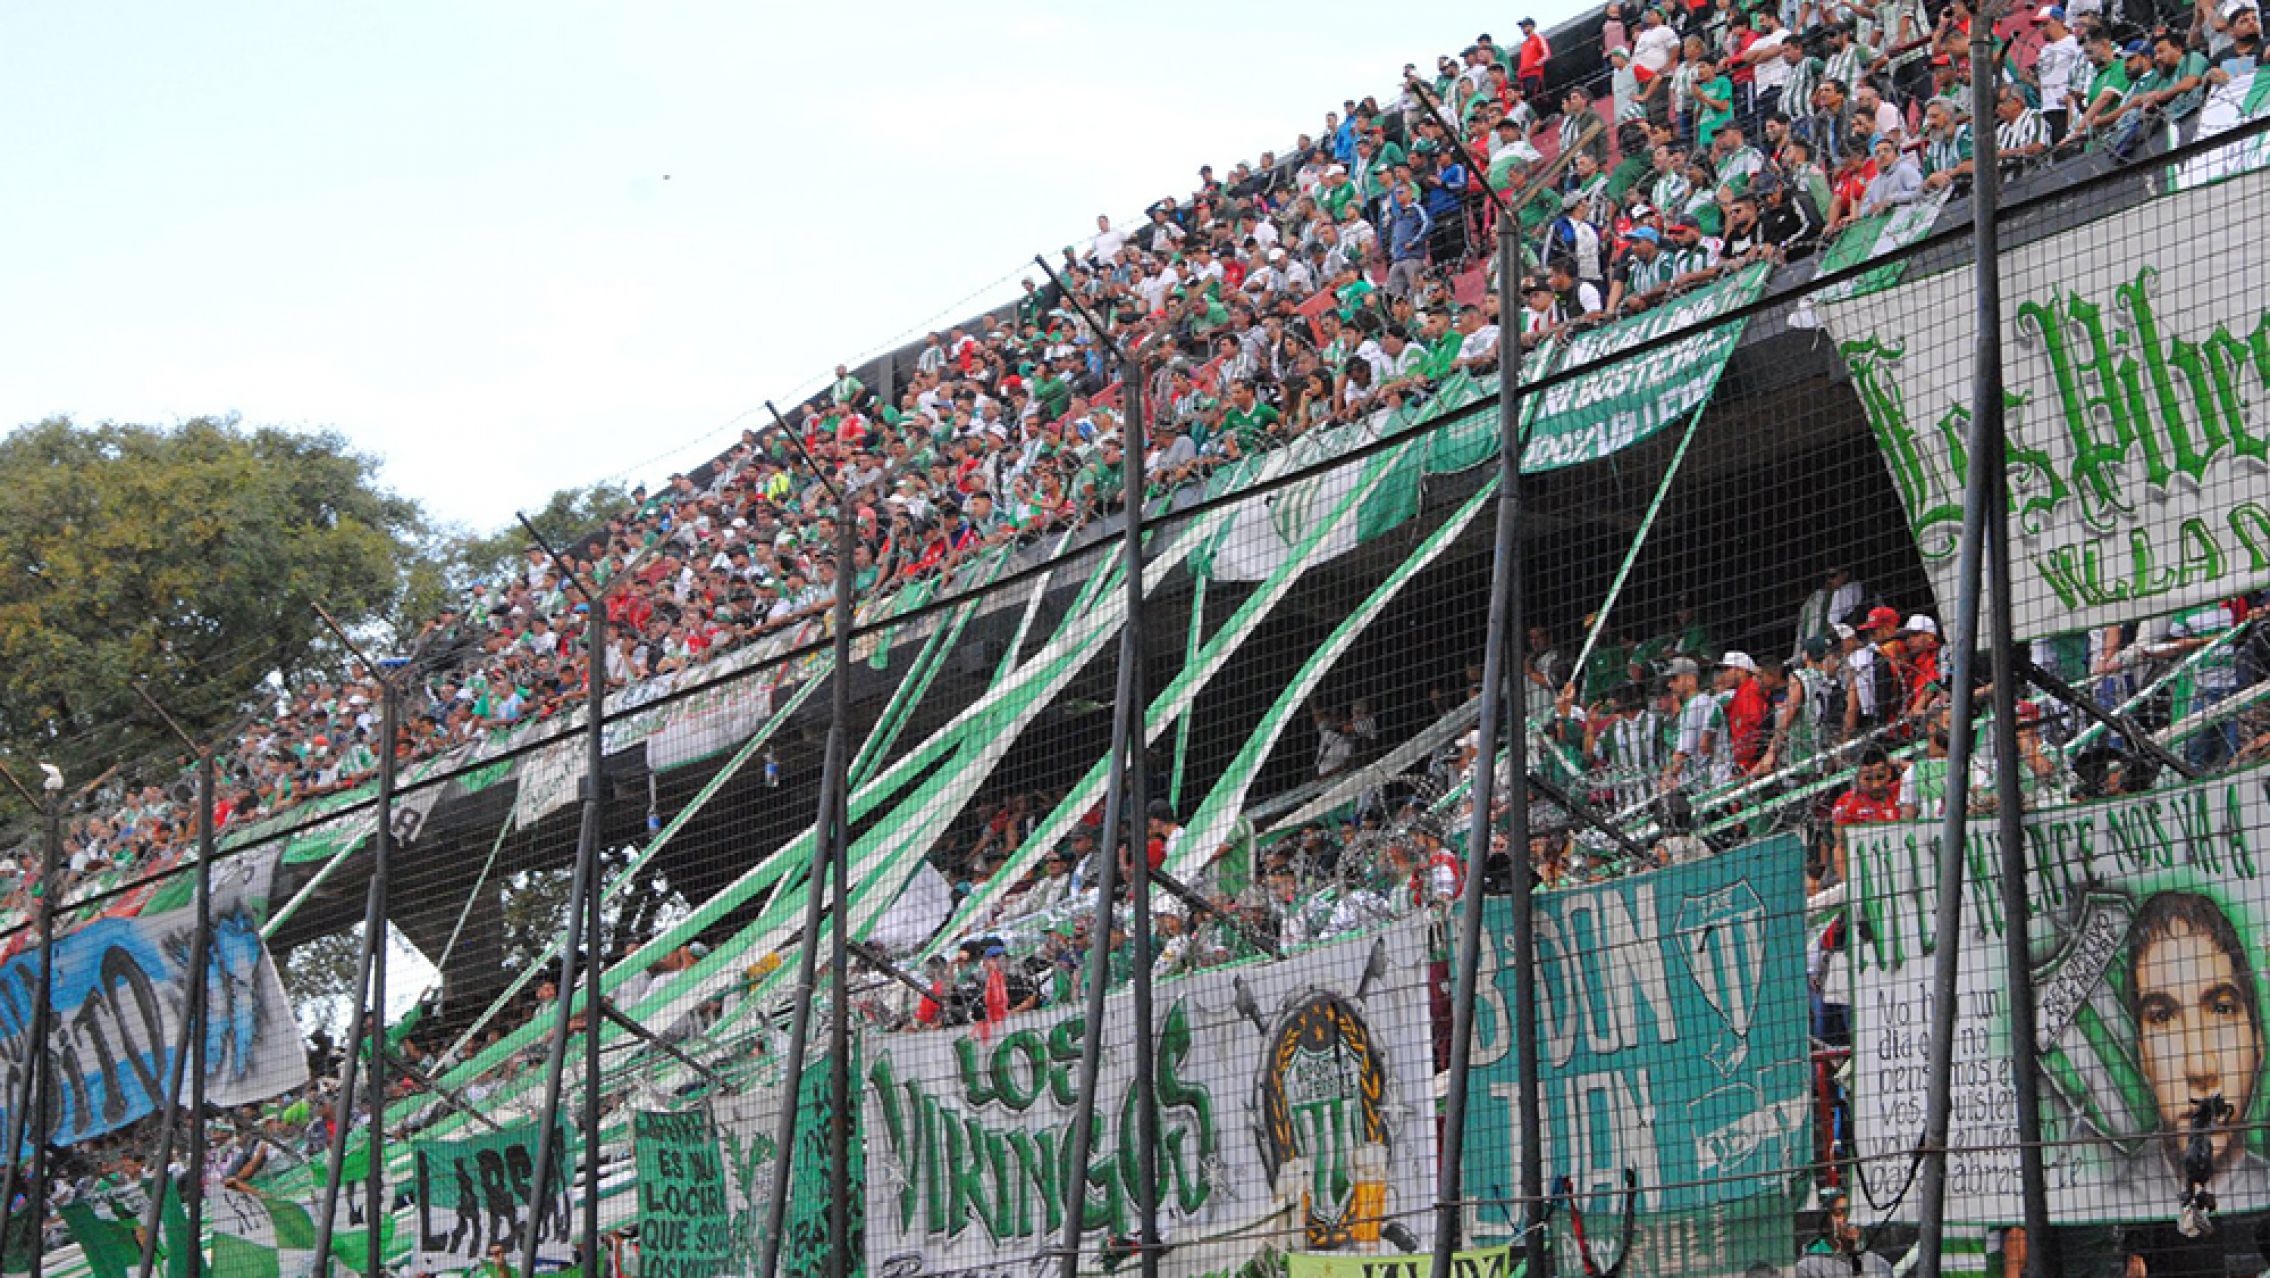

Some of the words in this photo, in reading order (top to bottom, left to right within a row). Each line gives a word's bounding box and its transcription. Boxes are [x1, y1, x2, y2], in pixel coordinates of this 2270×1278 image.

[2106, 801, 2173, 872] NOS
[953, 1011, 1088, 1112] LOS
[868, 992, 1213, 1254] VIKINGOS
[641, 1217, 689, 1252] QUE
